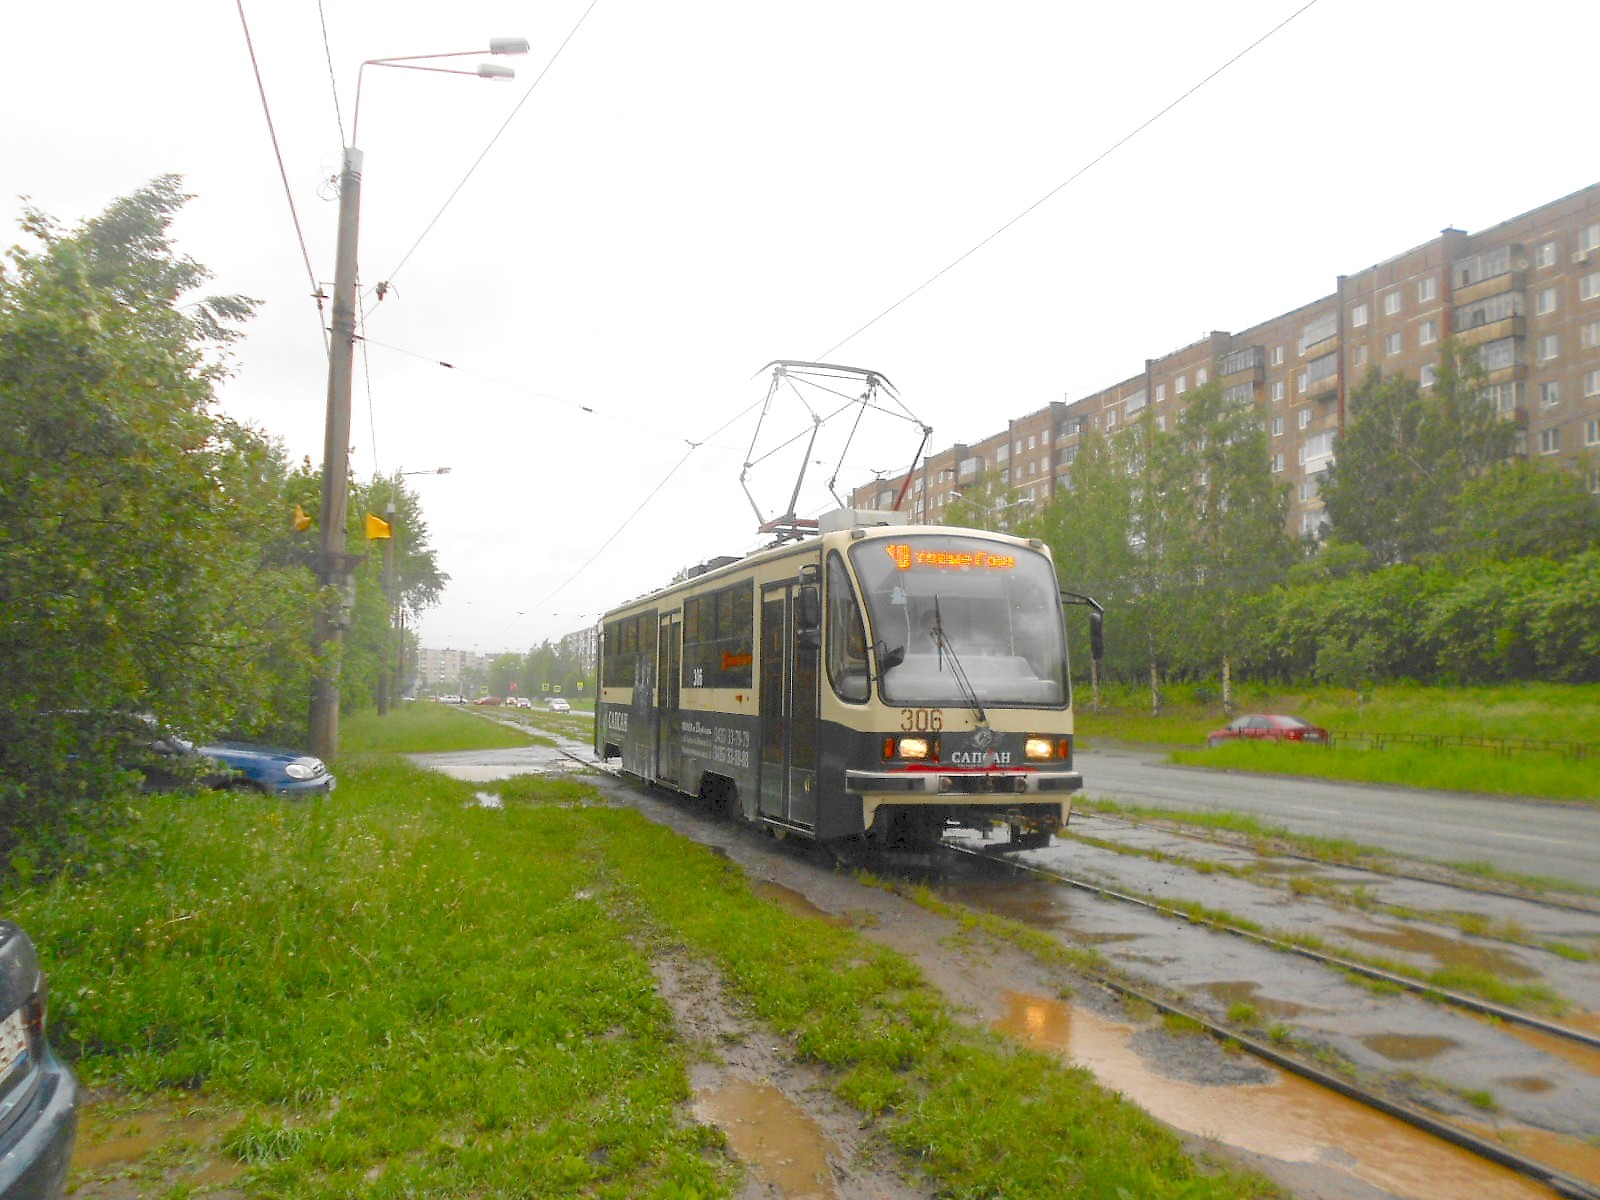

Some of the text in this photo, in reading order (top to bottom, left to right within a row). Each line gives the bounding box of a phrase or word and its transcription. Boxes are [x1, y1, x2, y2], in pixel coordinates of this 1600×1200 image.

[693, 667, 703, 687] 306
[901, 708, 942, 732] 306
[951, 751, 1011, 764] САПАН
